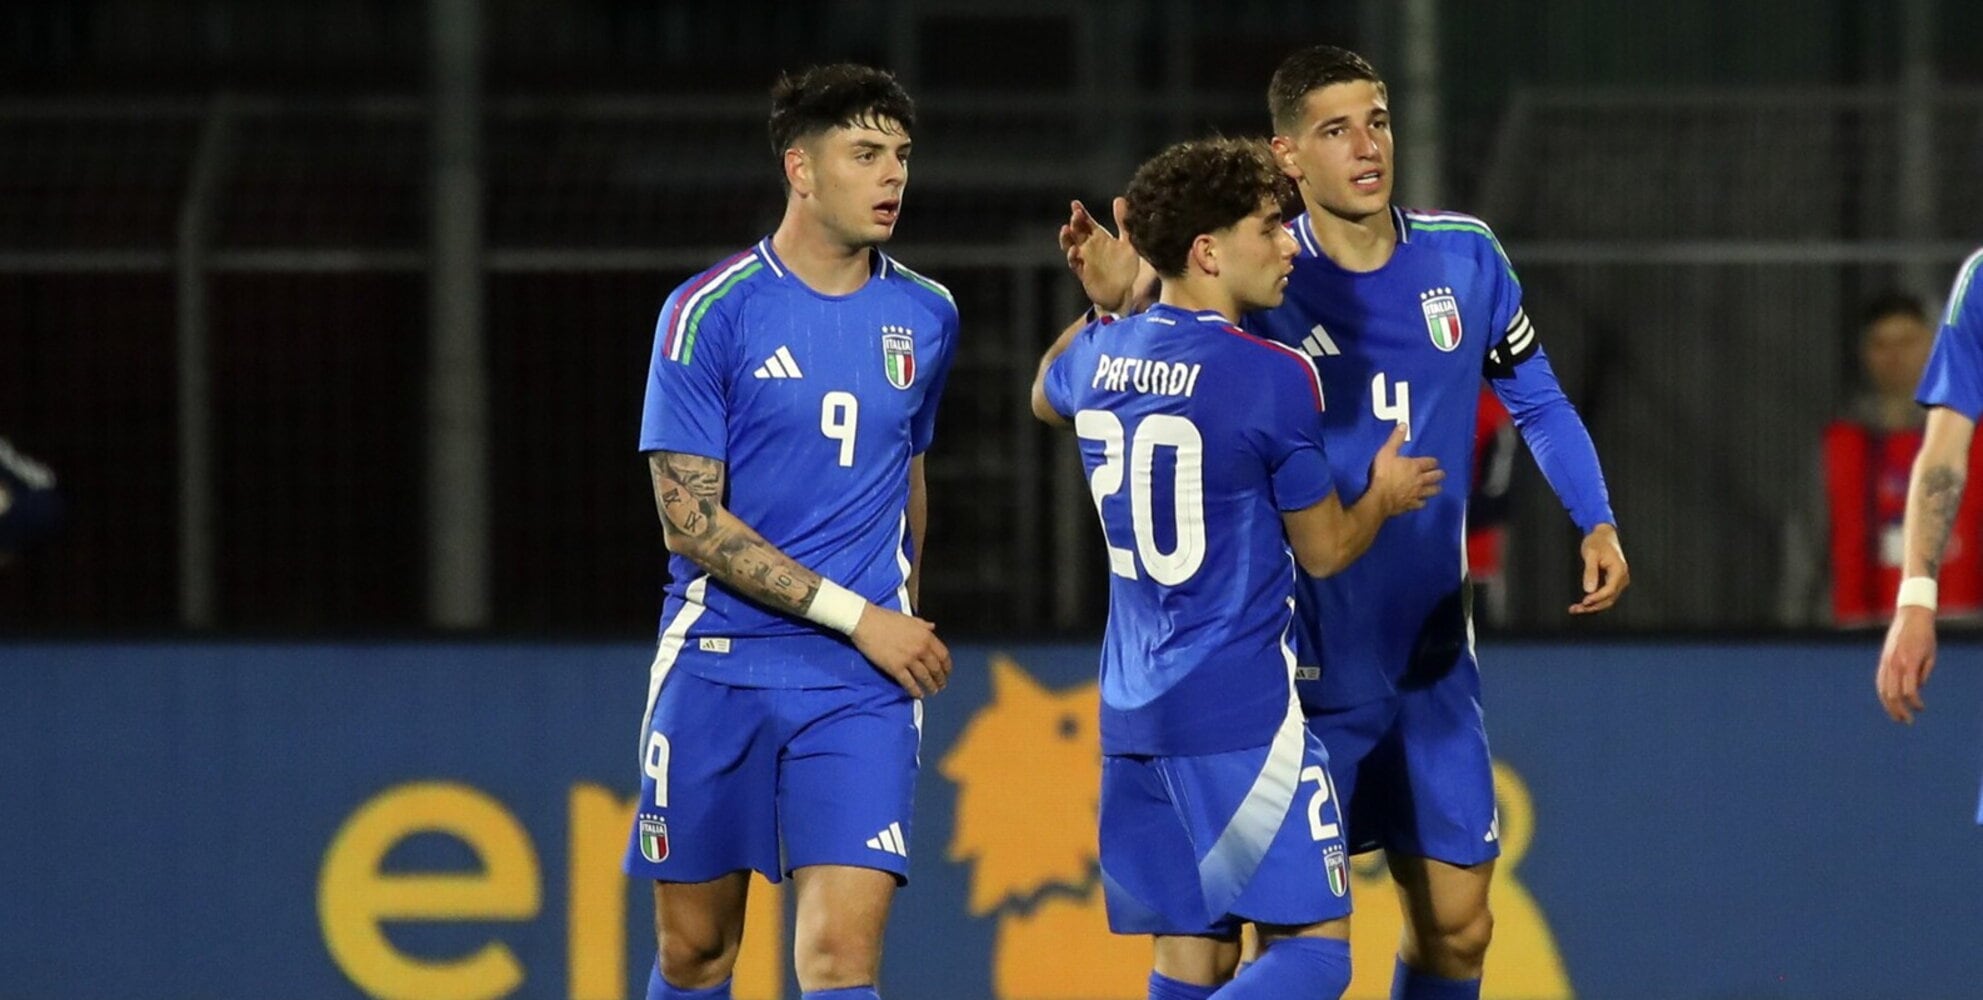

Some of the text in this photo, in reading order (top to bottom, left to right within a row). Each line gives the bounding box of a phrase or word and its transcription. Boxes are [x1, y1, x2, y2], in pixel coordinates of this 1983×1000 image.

[885, 338, 912, 351] ITALIA
[1092, 354, 1201, 397] PAFUNDI
[821, 391, 858, 467] 9
[1372, 372, 1411, 442] 4
[1075, 409, 1206, 586] 20
[645, 730, 670, 808] 9
[1301, 765, 1345, 841] 2
